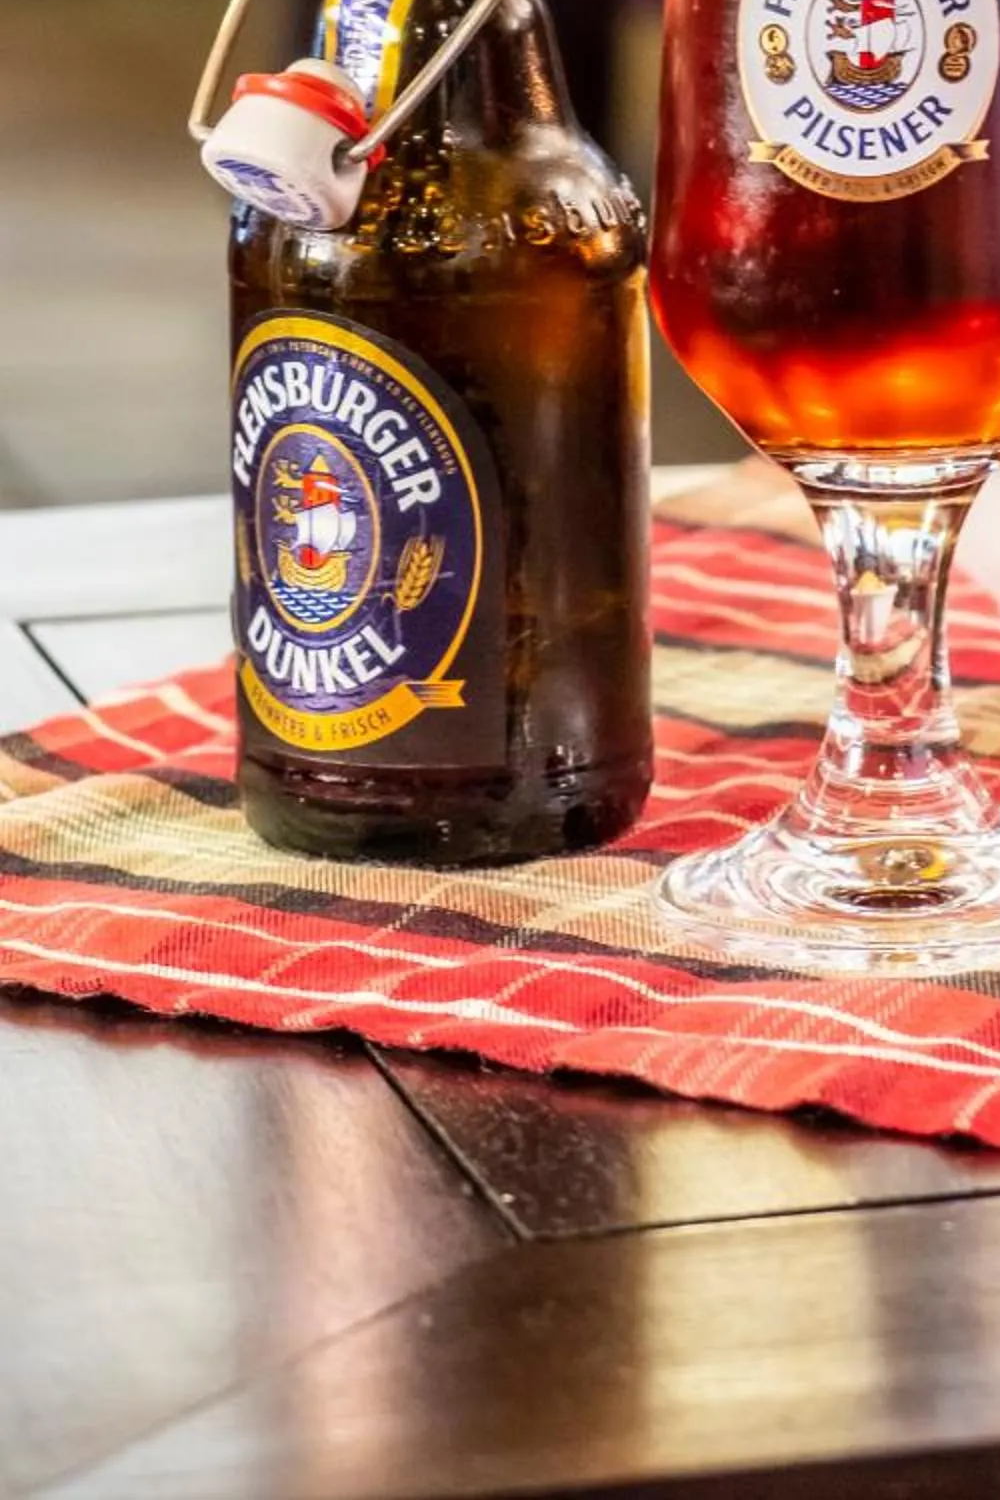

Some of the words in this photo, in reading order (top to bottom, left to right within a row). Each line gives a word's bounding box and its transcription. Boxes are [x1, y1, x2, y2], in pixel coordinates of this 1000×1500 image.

[783, 95, 953, 161] PILSENER
[232, 361, 442, 512] FLENSBURGER
[247, 606, 405, 693] DUNKEL
[330, 707, 392, 740] FRISCH
